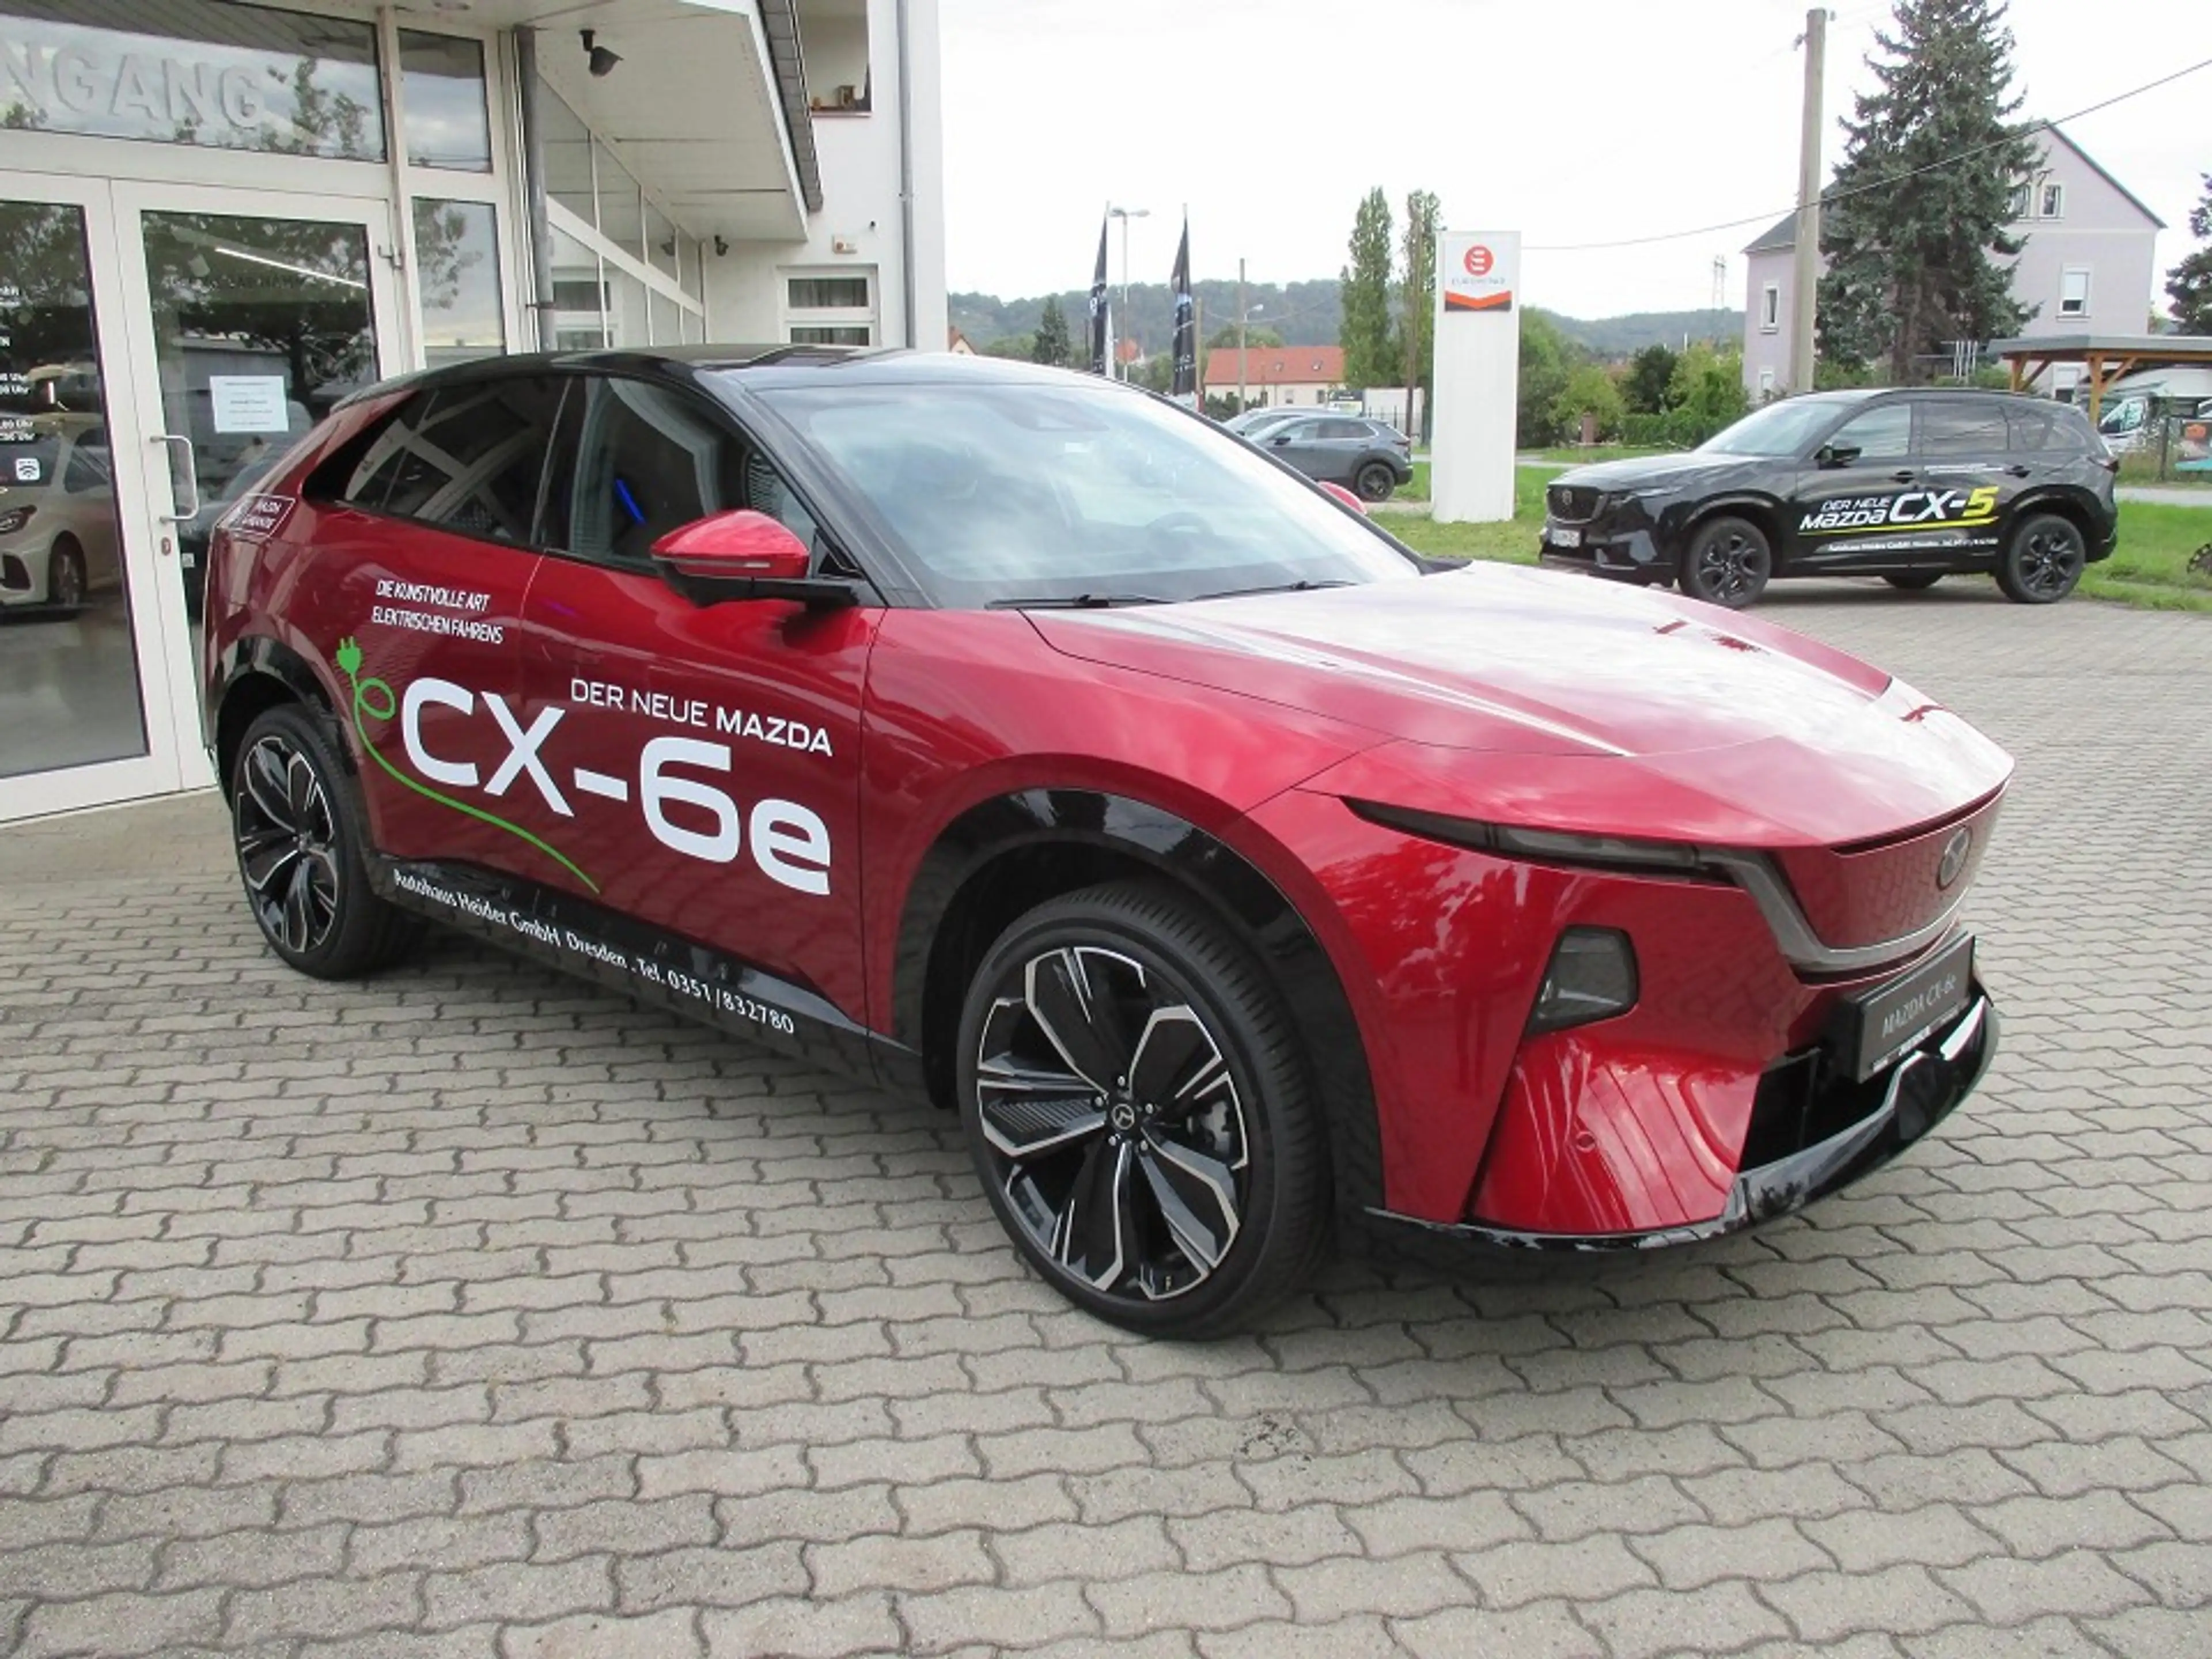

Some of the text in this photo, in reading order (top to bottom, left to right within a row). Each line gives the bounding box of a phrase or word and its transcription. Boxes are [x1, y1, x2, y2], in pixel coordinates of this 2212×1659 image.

[1889, 486, 1999, 522] CX-5
[376, 578, 490, 612] DIE KUNSTVOLLE ART
[372, 606, 503, 644] ELEKTRISCHEN FAHRENS
[571, 679, 833, 757] DER NEUE MAZDA
[402, 677, 831, 895] CX-6e
[510, 912, 561, 947] GmbH
